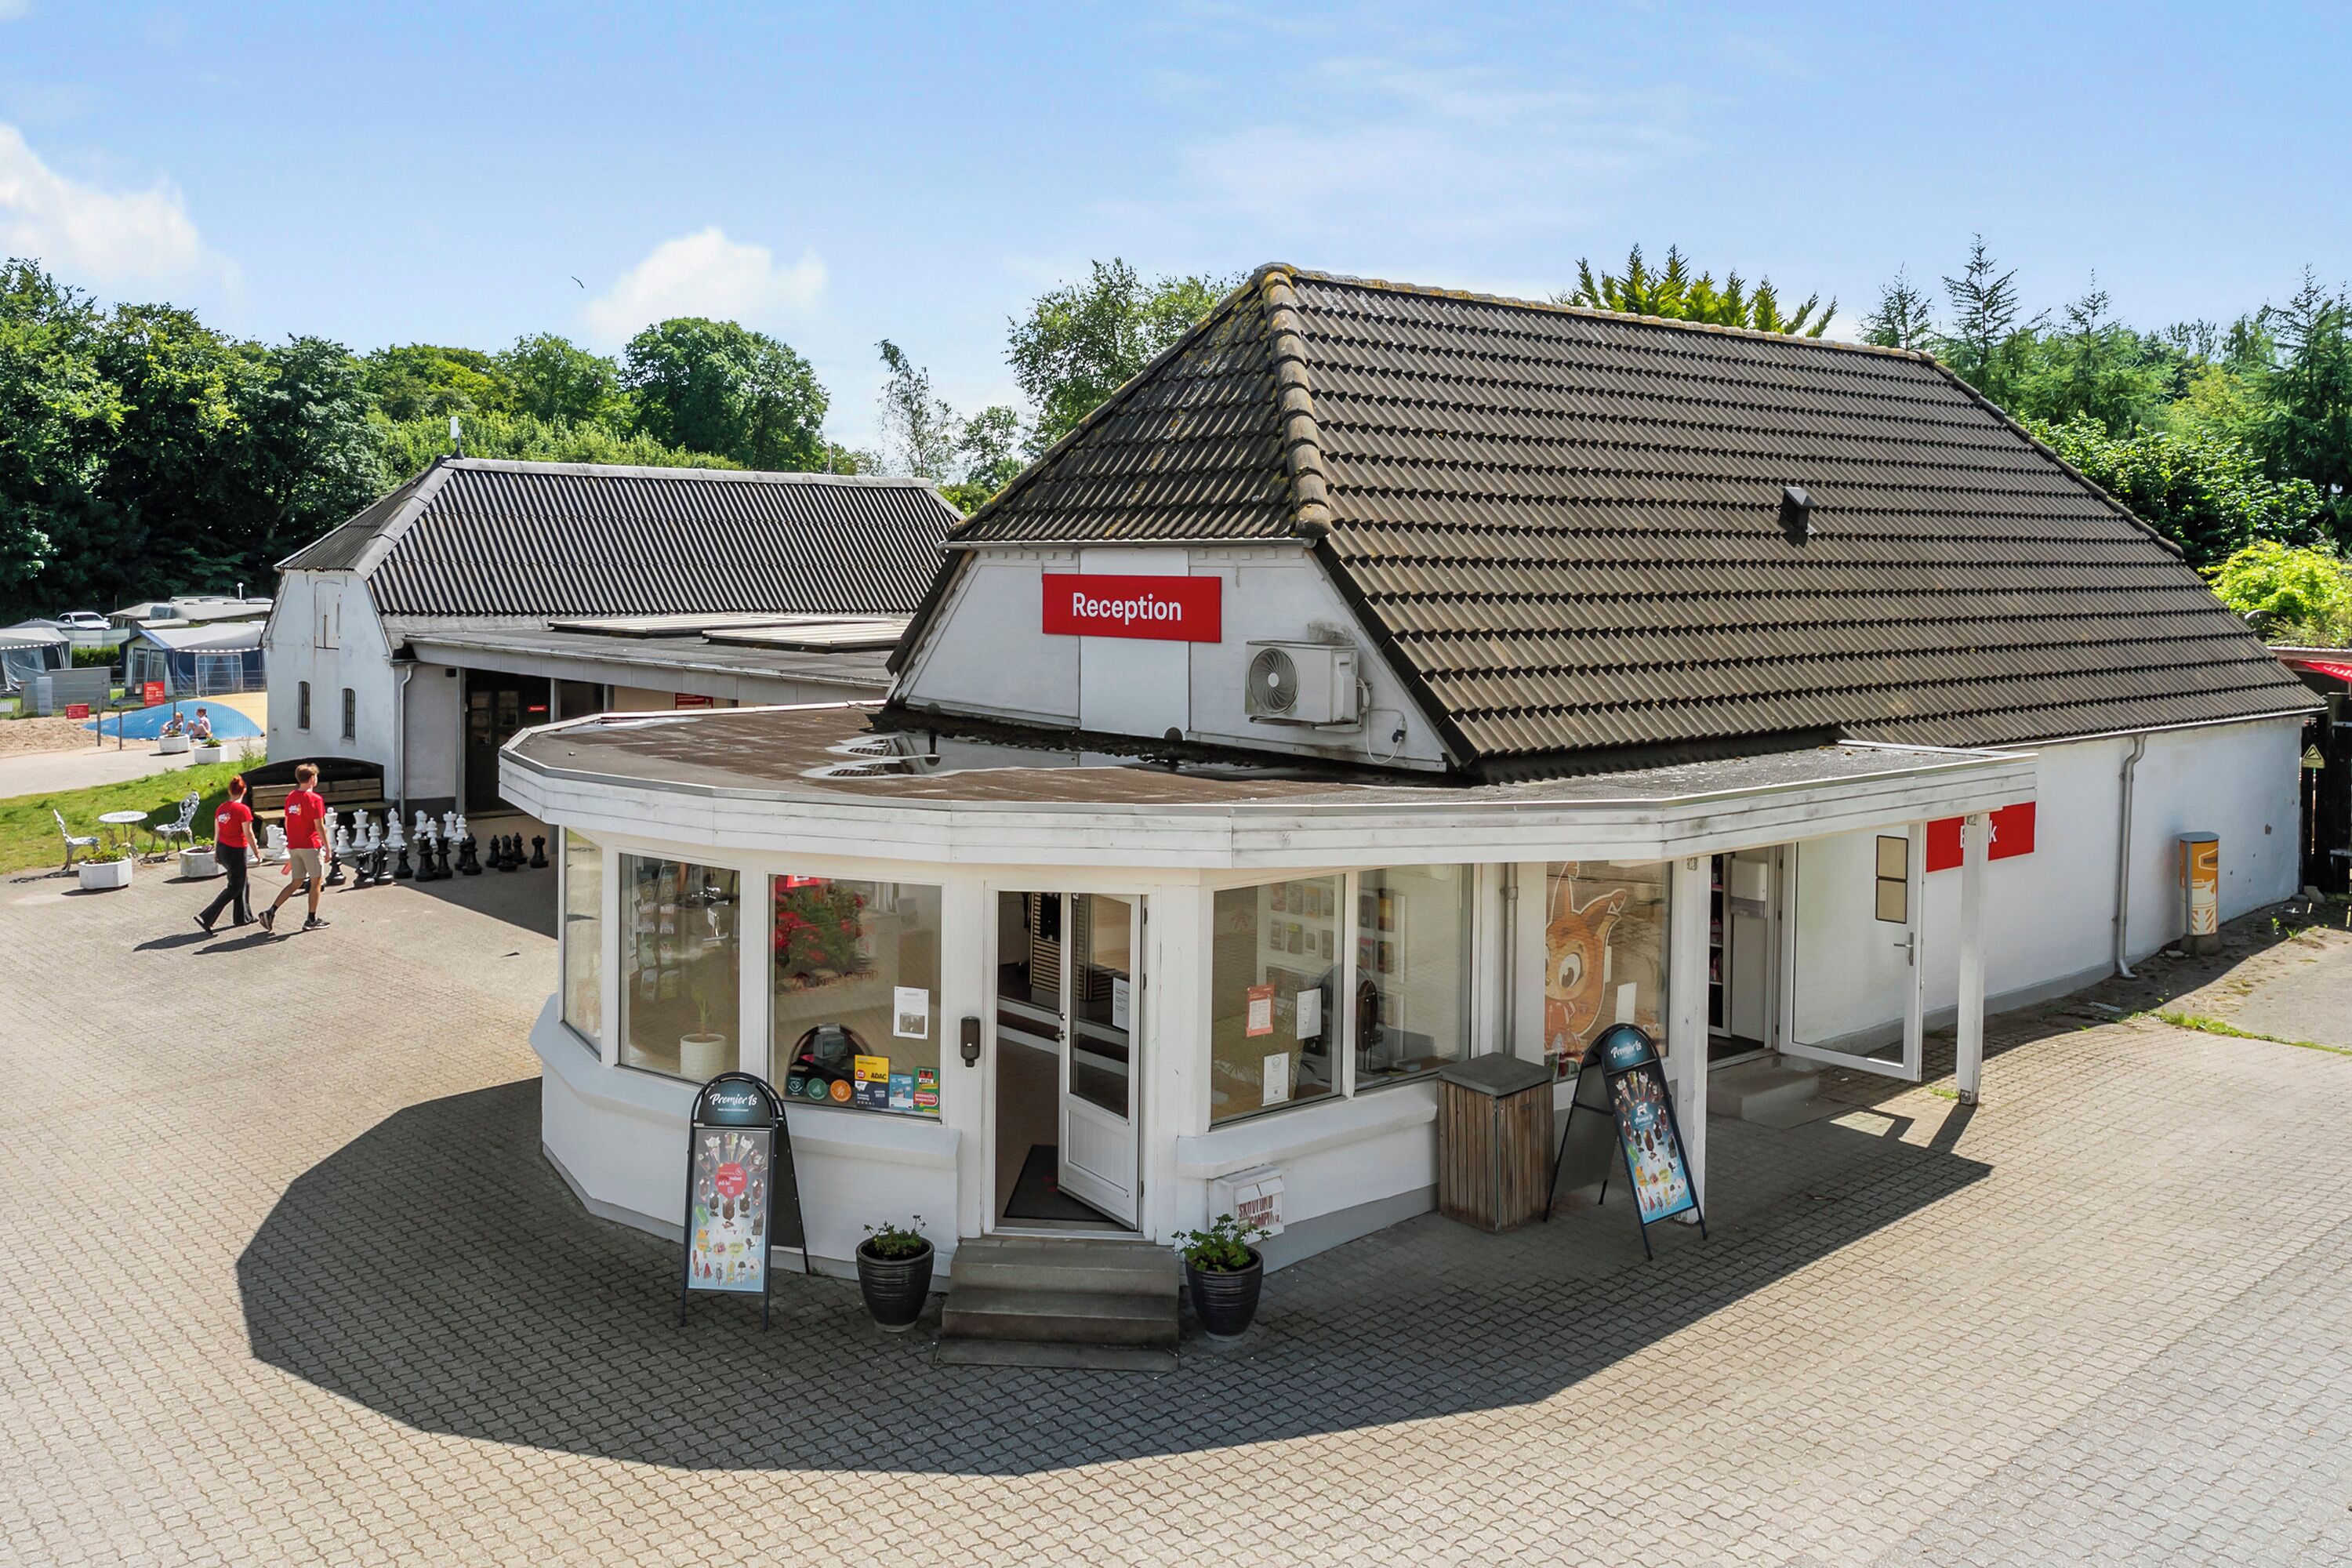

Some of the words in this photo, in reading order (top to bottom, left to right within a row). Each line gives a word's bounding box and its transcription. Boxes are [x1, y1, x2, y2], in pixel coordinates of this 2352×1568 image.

[1072, 592, 1182, 625] Reception
[870, 1072, 887, 1080] ADAC
[710, 1093, 747, 1105] Premier
[748, 1094, 757, 1106] Is
